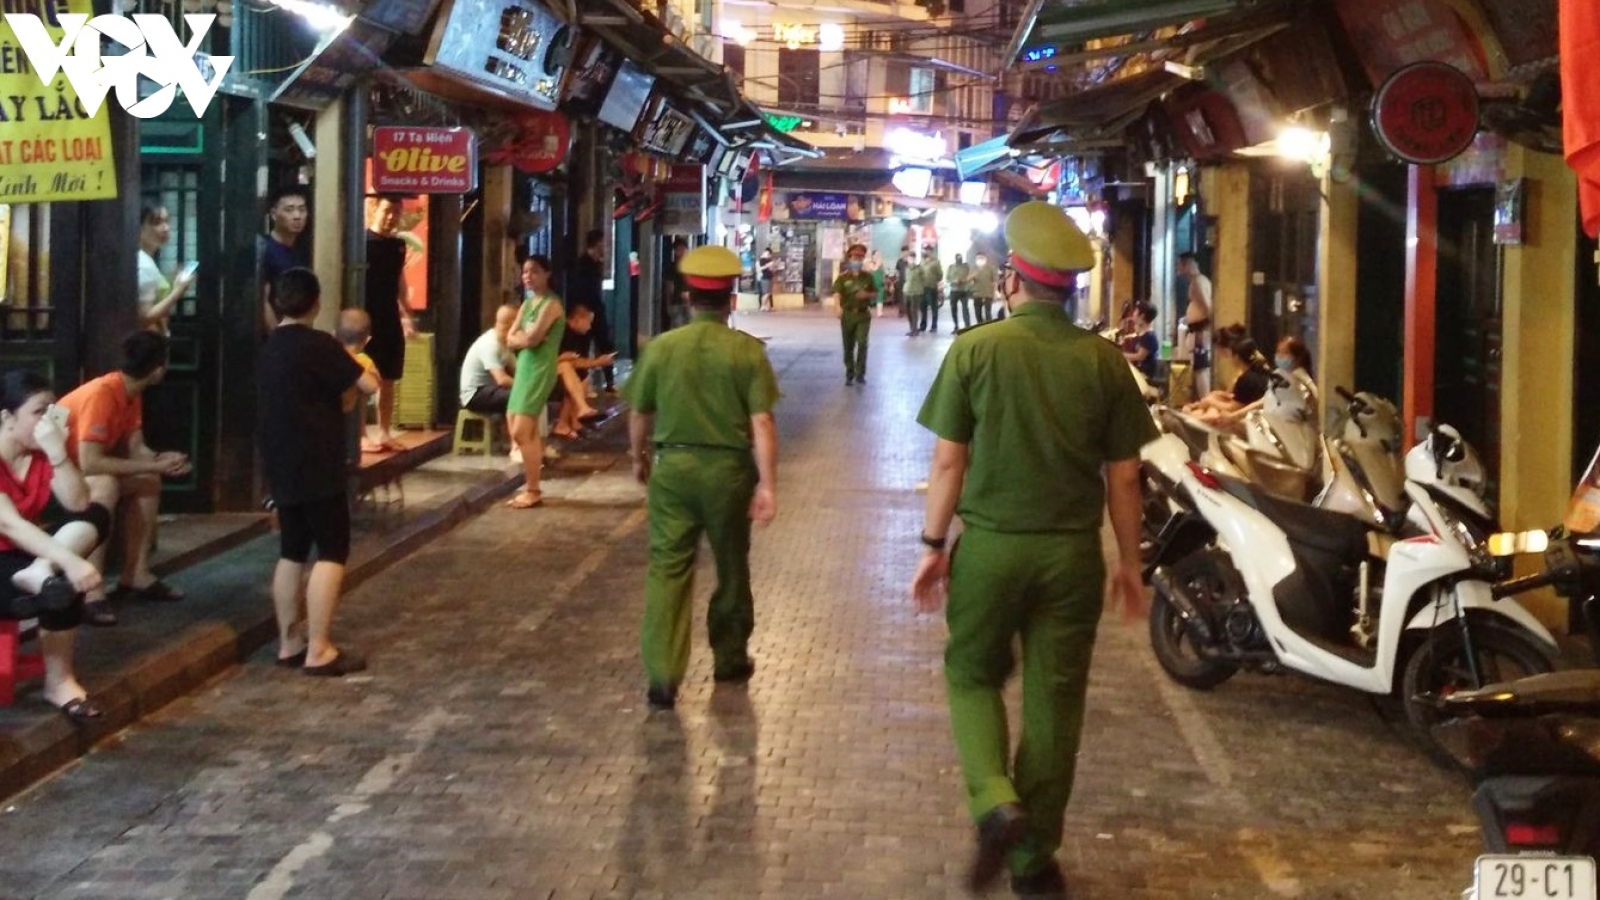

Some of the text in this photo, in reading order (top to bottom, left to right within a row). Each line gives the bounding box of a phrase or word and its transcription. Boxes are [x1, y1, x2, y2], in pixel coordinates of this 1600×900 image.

[394, 132, 405, 142] 17
[380, 147, 466, 172] Olive
[381, 176, 465, 187] Snacks & Drinks
[1494, 862, 1574, 898] 29-C1
